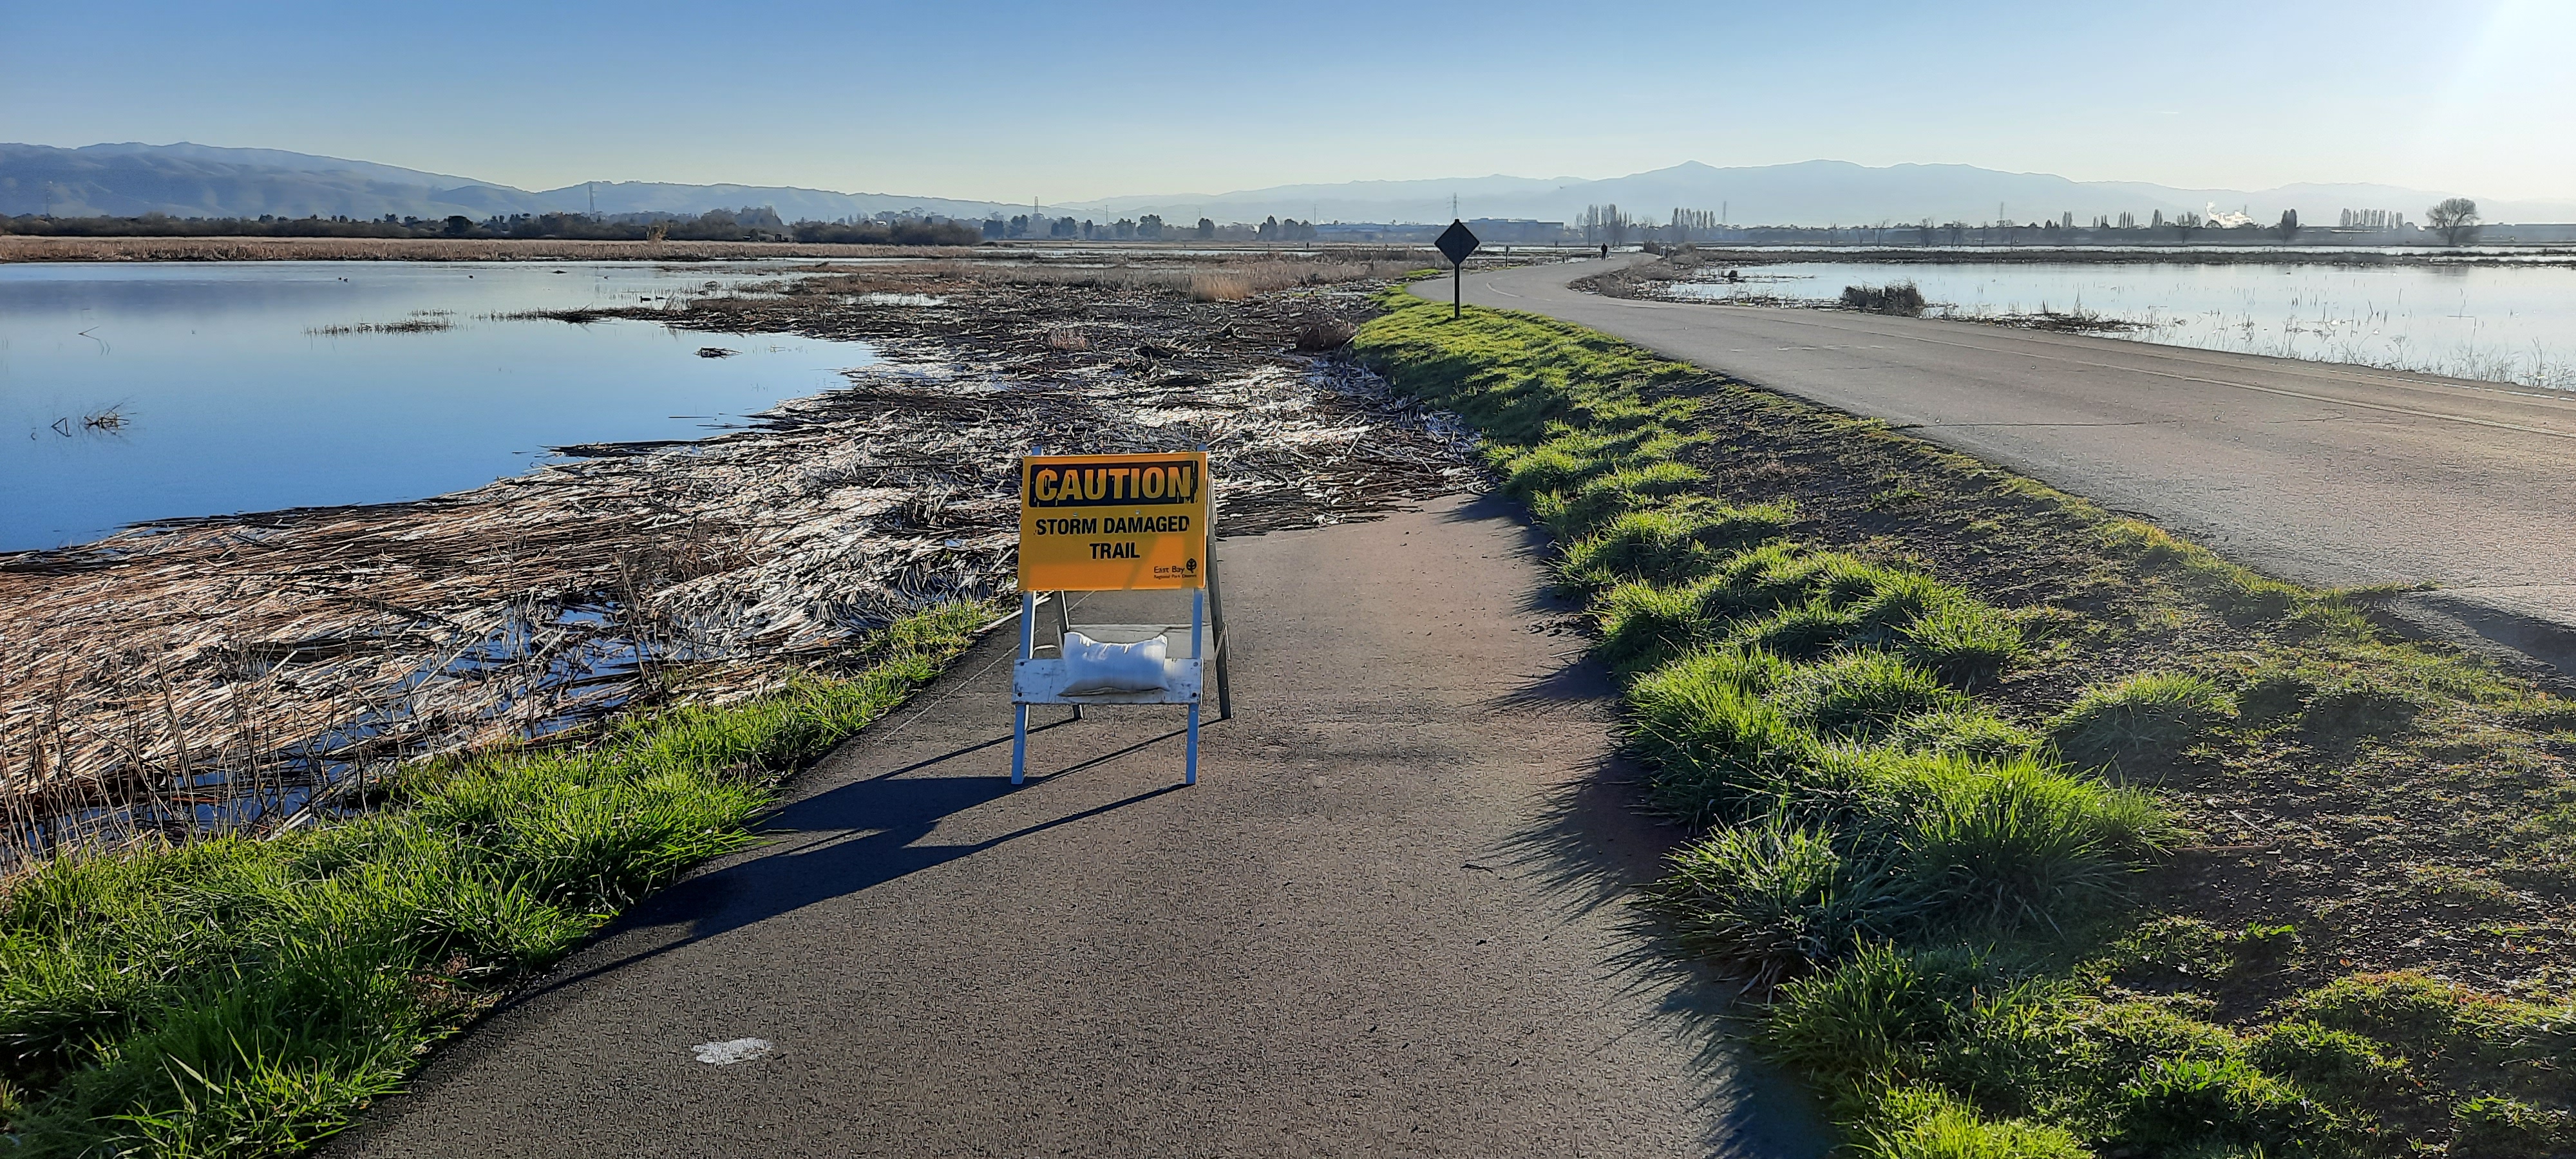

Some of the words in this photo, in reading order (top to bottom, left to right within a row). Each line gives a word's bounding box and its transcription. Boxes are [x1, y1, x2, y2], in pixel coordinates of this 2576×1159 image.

[1035, 466, 1191, 501] CAUTION
[1036, 518, 1097, 535] STORM
[1104, 516, 1189, 534] DAMAGED
[1090, 543, 1141, 560] TRAIL
[1172, 565, 1185, 574] Bay
